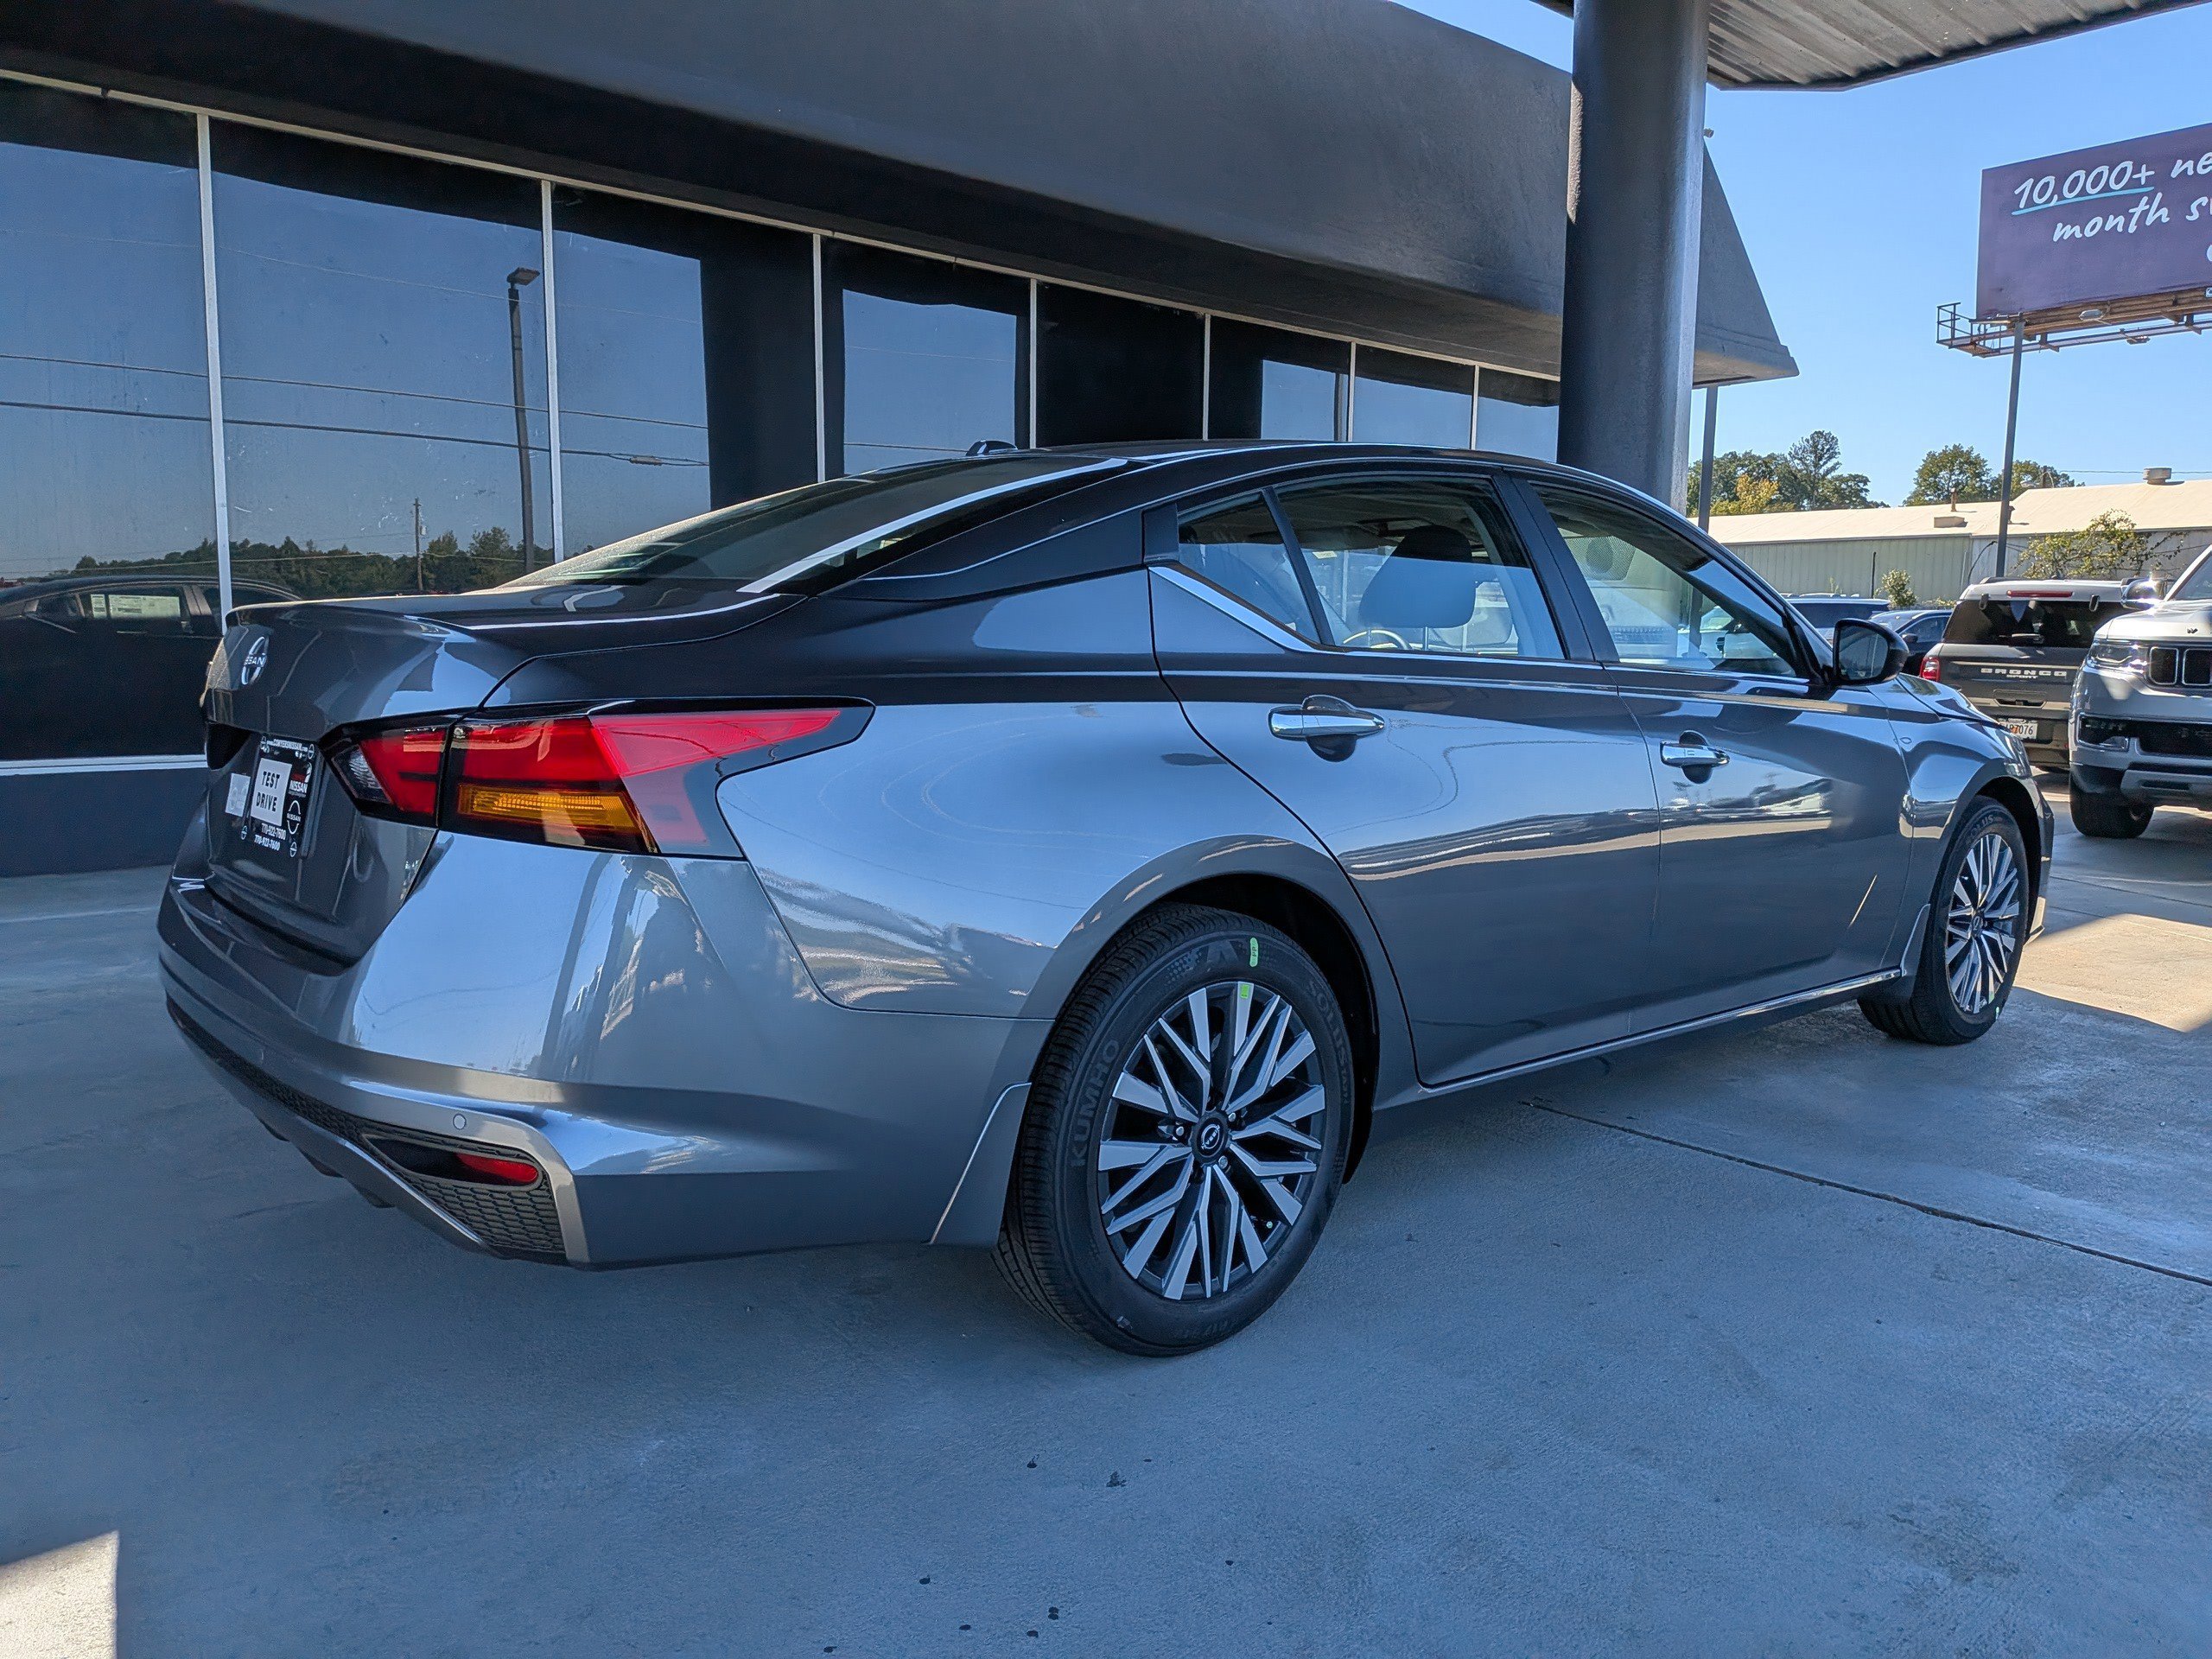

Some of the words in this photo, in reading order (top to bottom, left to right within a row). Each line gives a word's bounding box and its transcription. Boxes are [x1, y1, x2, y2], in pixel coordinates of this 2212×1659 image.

[2013, 161, 2155, 209] 10,000+
[2052, 192, 2170, 242] month
[2185, 196, 2212, 221] s
[1980, 667, 2067, 677] BRONCO
[261, 771, 281, 790] TEST
[289, 780, 308, 793] NISSAN
[256, 791, 278, 812] DRIVE
[286, 812, 302, 822] NISSAN
[1071, 1039, 1120, 1167] KUMHO
